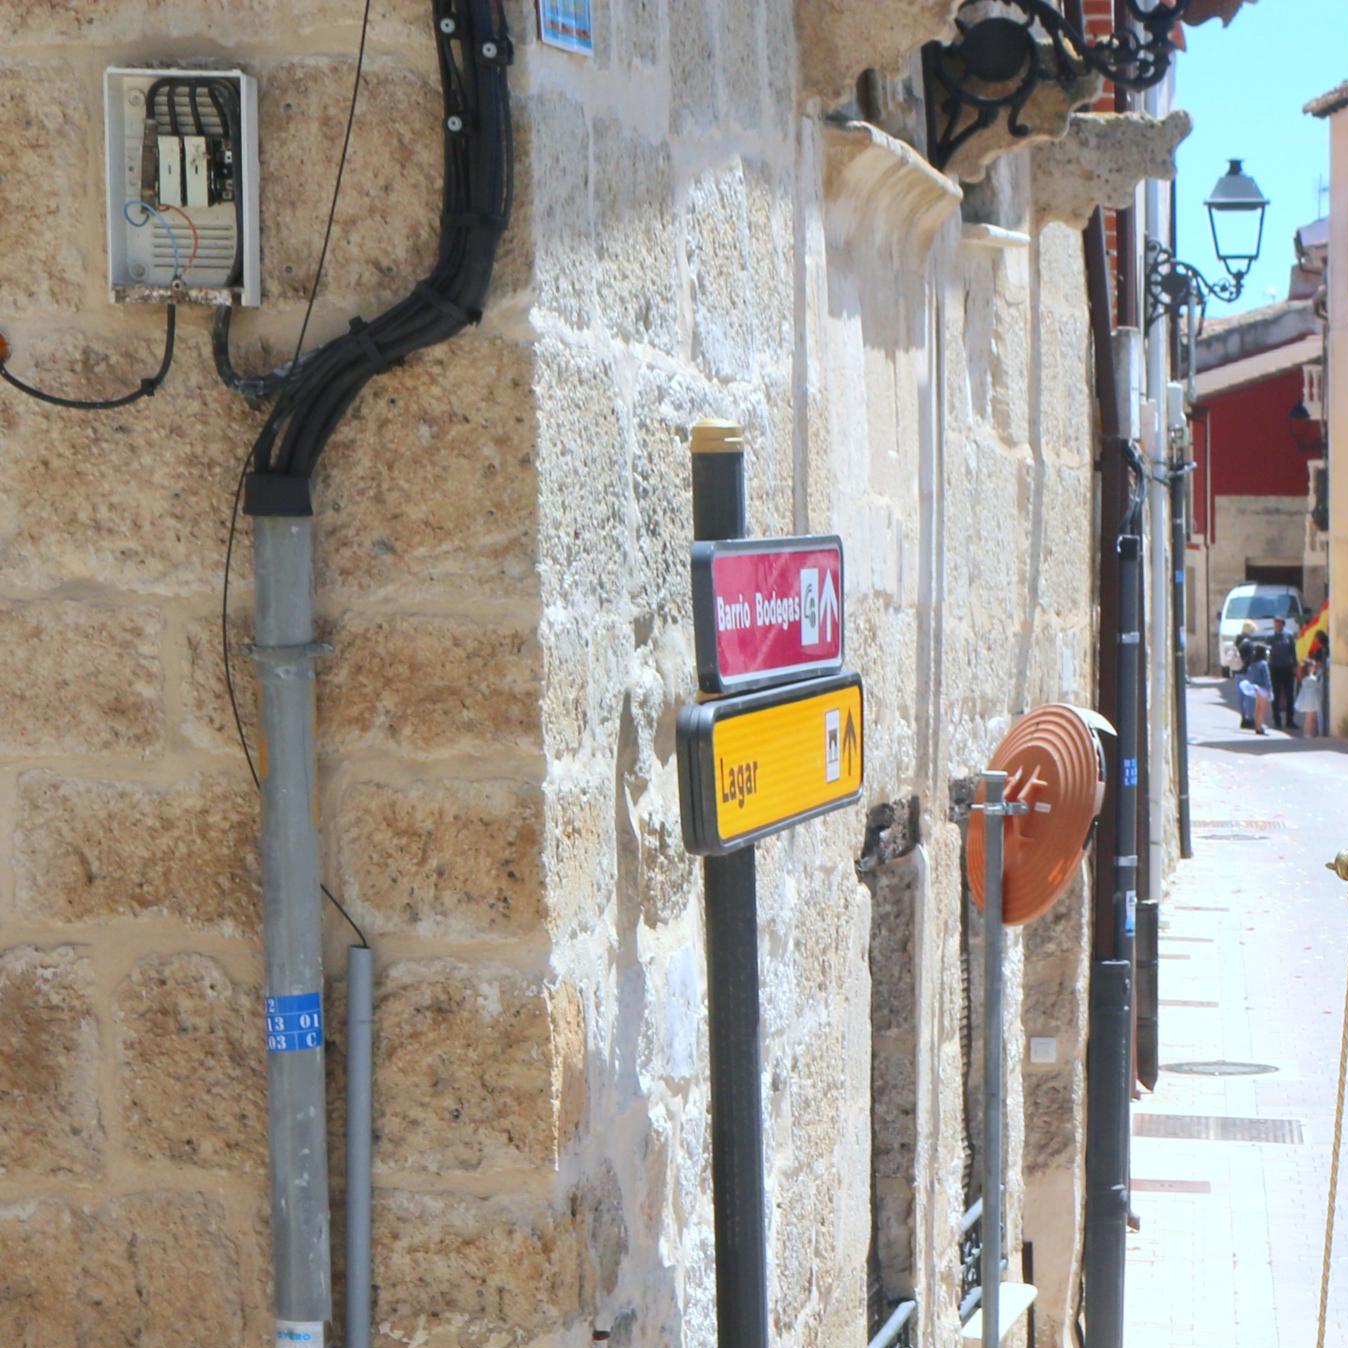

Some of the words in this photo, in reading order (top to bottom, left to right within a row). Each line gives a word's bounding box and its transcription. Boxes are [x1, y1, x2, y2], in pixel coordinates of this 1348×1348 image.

[717, 593, 751, 631] Barrio
[755, 590, 800, 630] Bodegas
[720, 757, 758, 808] Lagar
[265, 998, 275, 1013] 2
[299, 1013, 319, 1029] 01
[268, 1035, 287, 1050] 03
[306, 1031, 317, 1047] C
